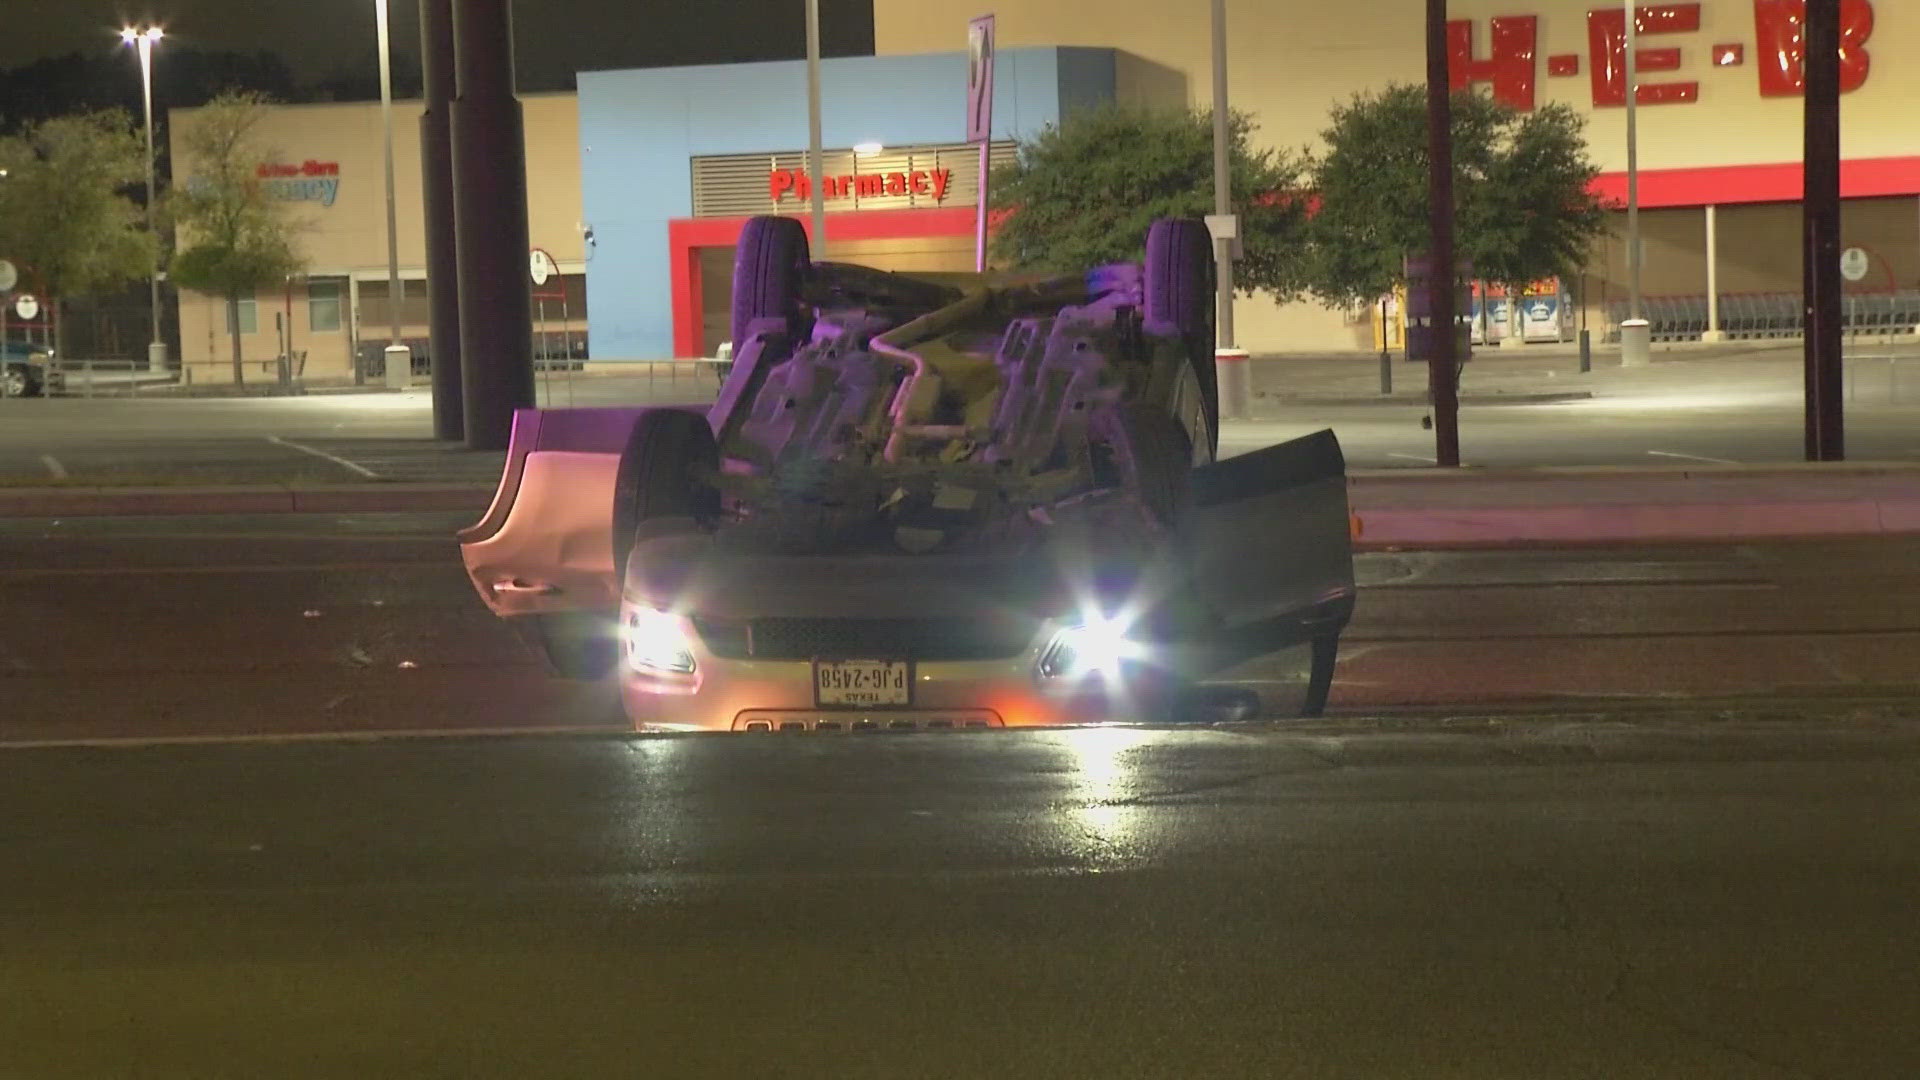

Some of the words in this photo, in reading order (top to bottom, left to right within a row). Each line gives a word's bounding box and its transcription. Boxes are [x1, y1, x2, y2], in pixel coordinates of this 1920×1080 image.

[1446, 0, 1873, 110] H-E-B
[769, 167, 951, 200] Pharmacy
[845, 693, 880, 702] TEXAS
